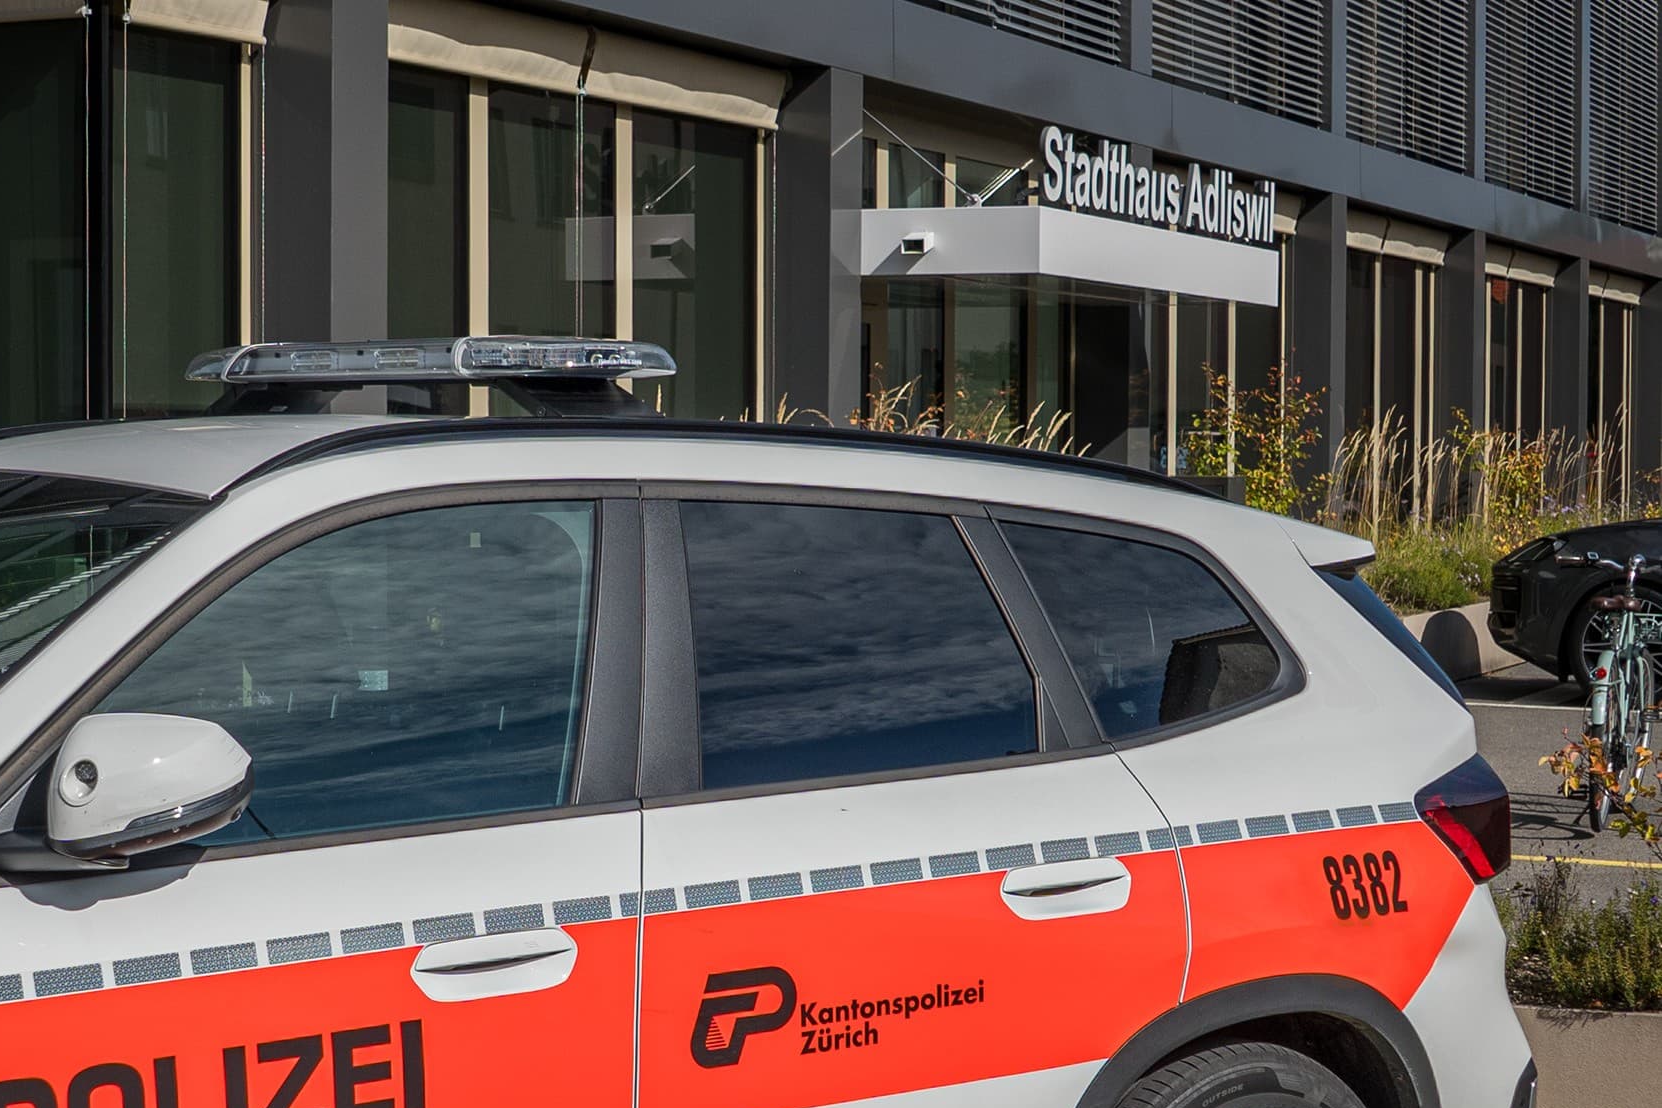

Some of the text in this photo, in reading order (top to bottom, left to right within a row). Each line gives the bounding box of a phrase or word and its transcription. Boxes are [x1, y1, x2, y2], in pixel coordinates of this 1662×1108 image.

[1041, 125, 1275, 243] Stadthaus Adliswil
[1322, 850, 1408, 920] 8382
[800, 979, 985, 1027] Kantonspolizei
[800, 1021, 879, 1055] Zürich
[1202, 1084, 1244, 1108] OUTSIDE
